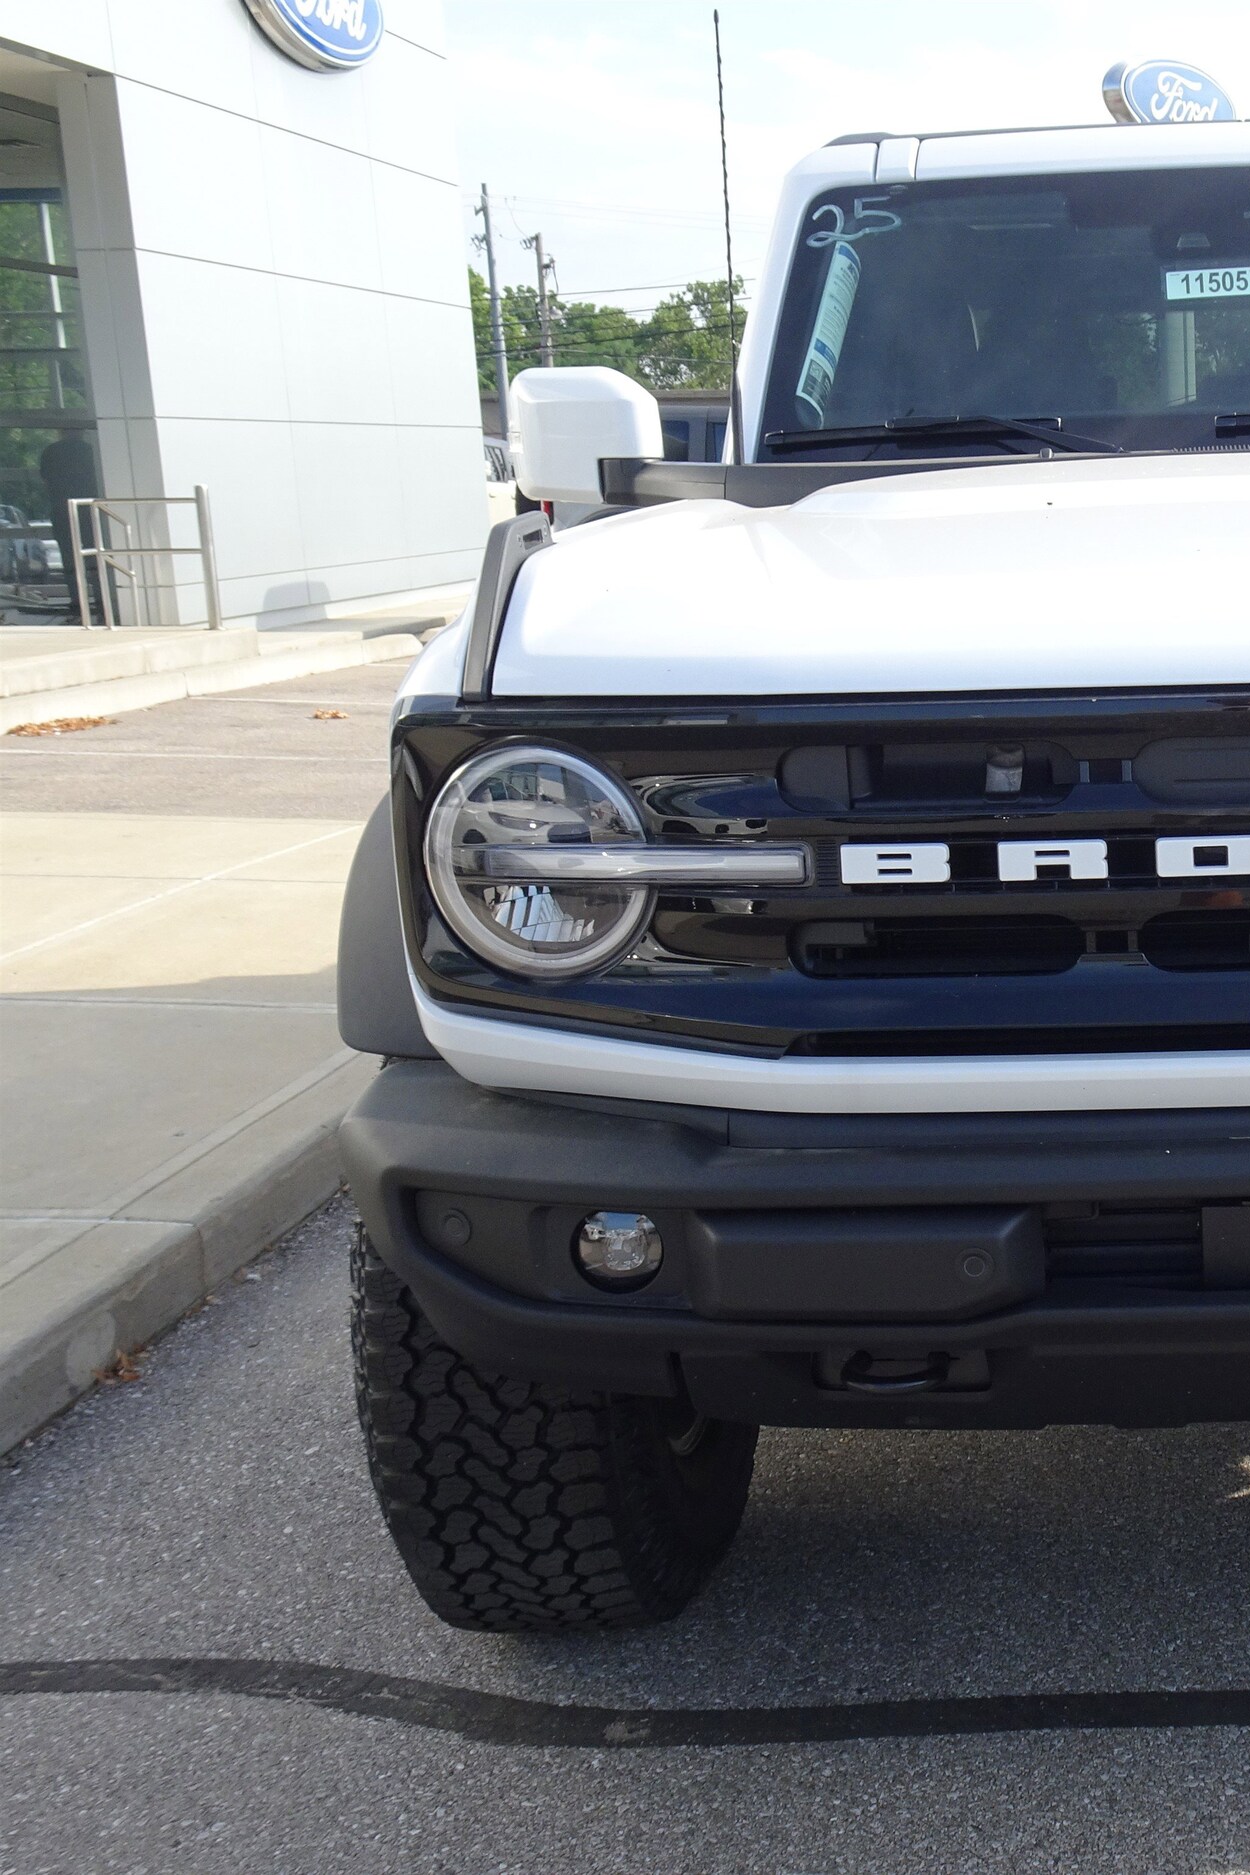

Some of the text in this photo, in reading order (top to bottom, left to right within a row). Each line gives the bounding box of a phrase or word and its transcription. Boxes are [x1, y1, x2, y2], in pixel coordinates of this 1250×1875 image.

[1150, 71, 1218, 121] Ford
[806, 196, 901, 248] 25
[1181, 271, 1249, 294] 11505
